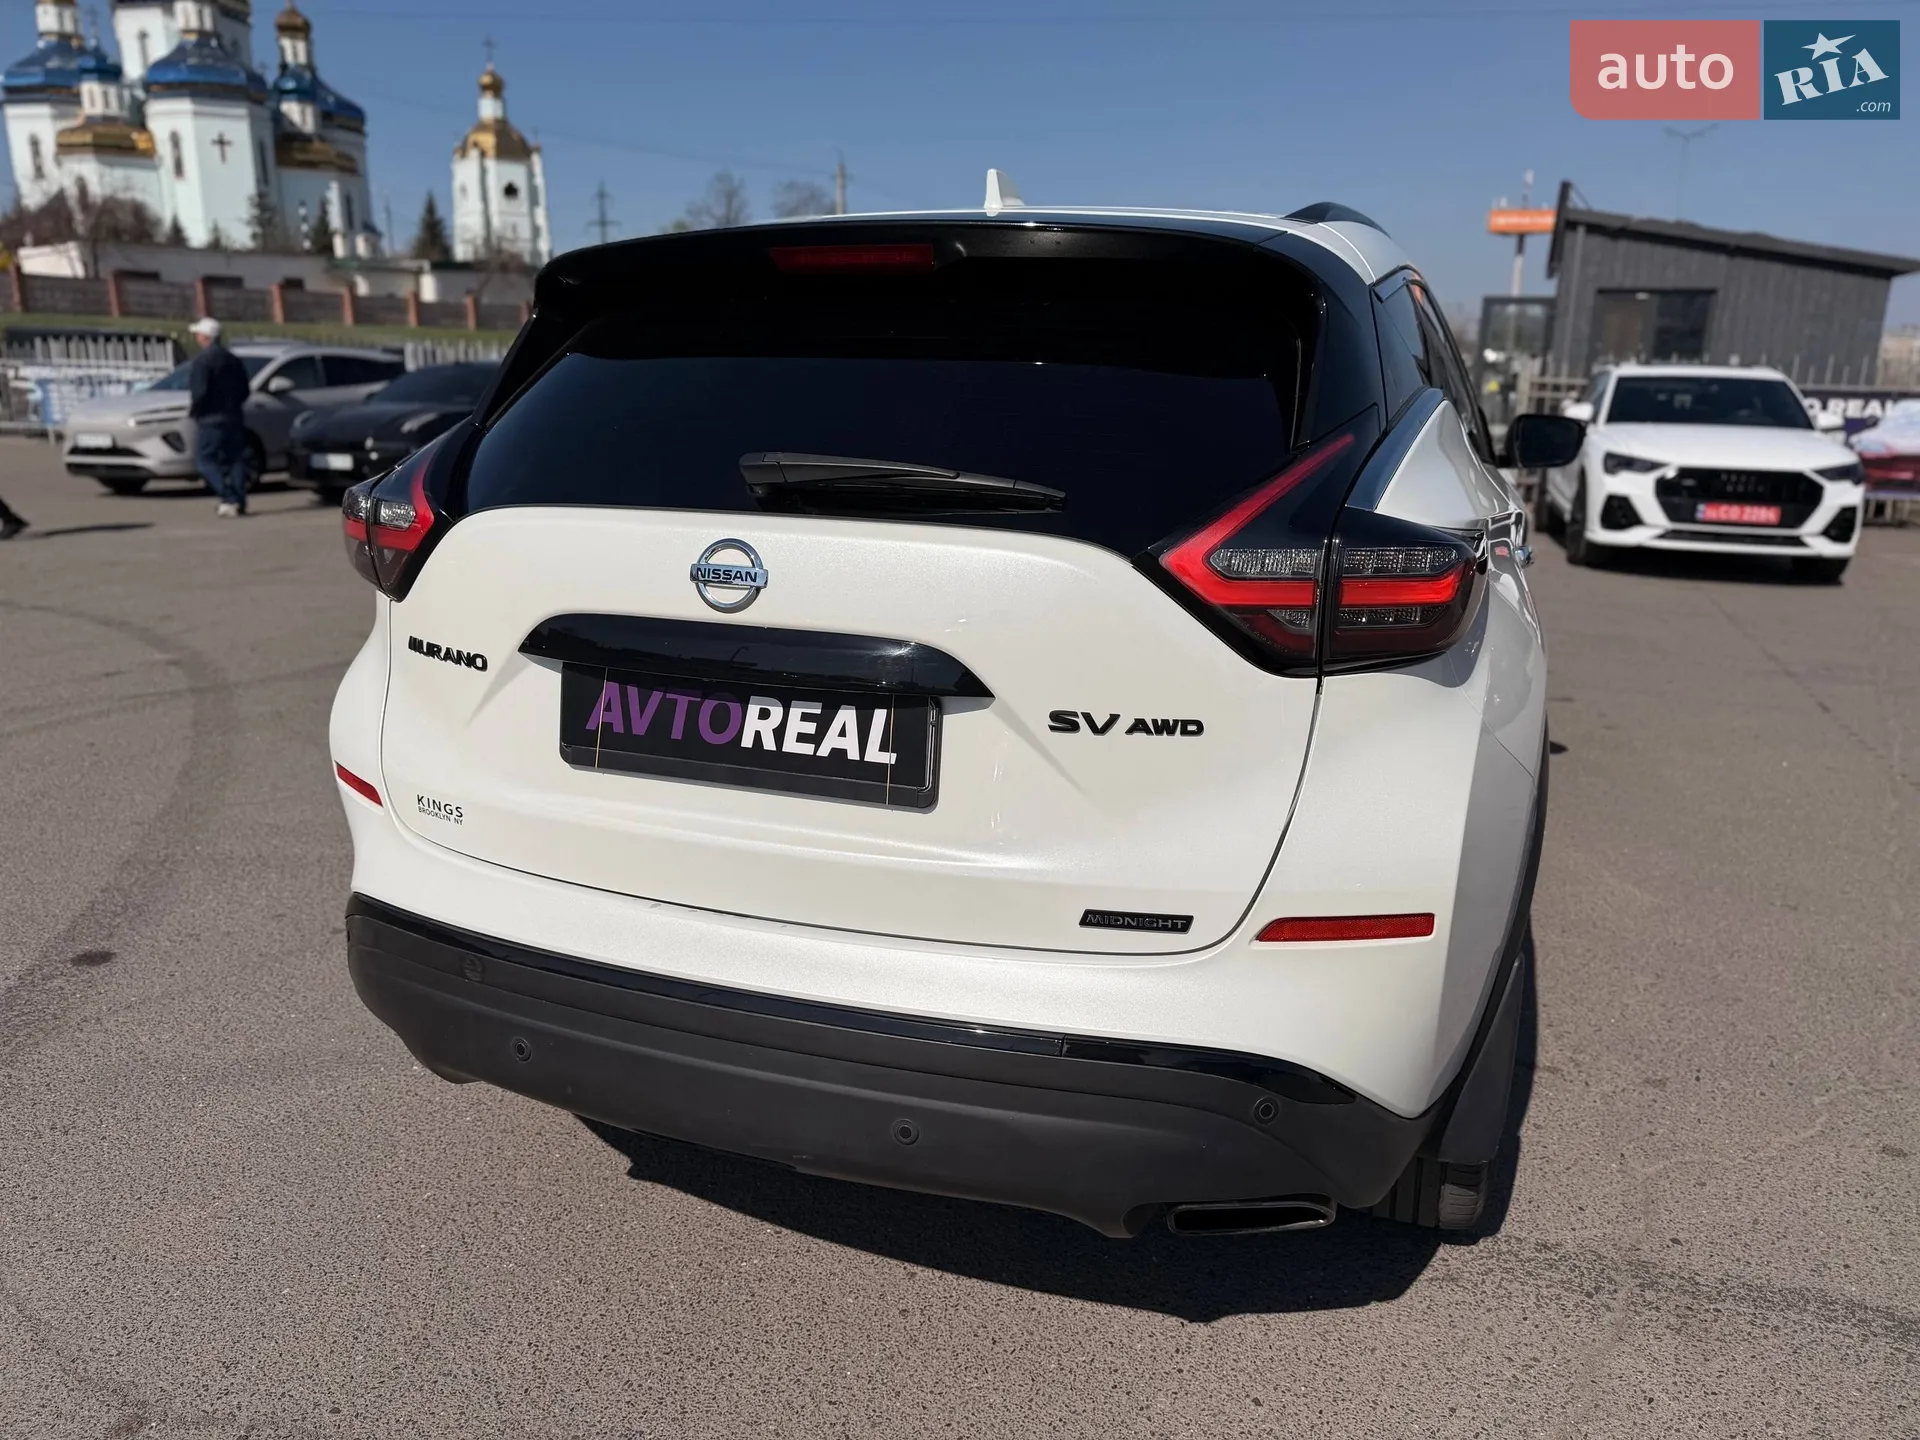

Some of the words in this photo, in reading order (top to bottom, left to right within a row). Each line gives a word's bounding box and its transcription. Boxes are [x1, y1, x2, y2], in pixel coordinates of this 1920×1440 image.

[696, 567, 757, 583] NISSAN
[408, 635, 488, 672] MURANO
[586, 681, 898, 764] AVTOREAL
[1048, 709, 1121, 736] SV
[1124, 718, 1205, 737] AWD
[417, 794, 463, 818] KINGS
[418, 806, 451, 822] BROOKLYN
[453, 817, 463, 826] NY
[1086, 914, 1187, 929] MIDNIGHT
